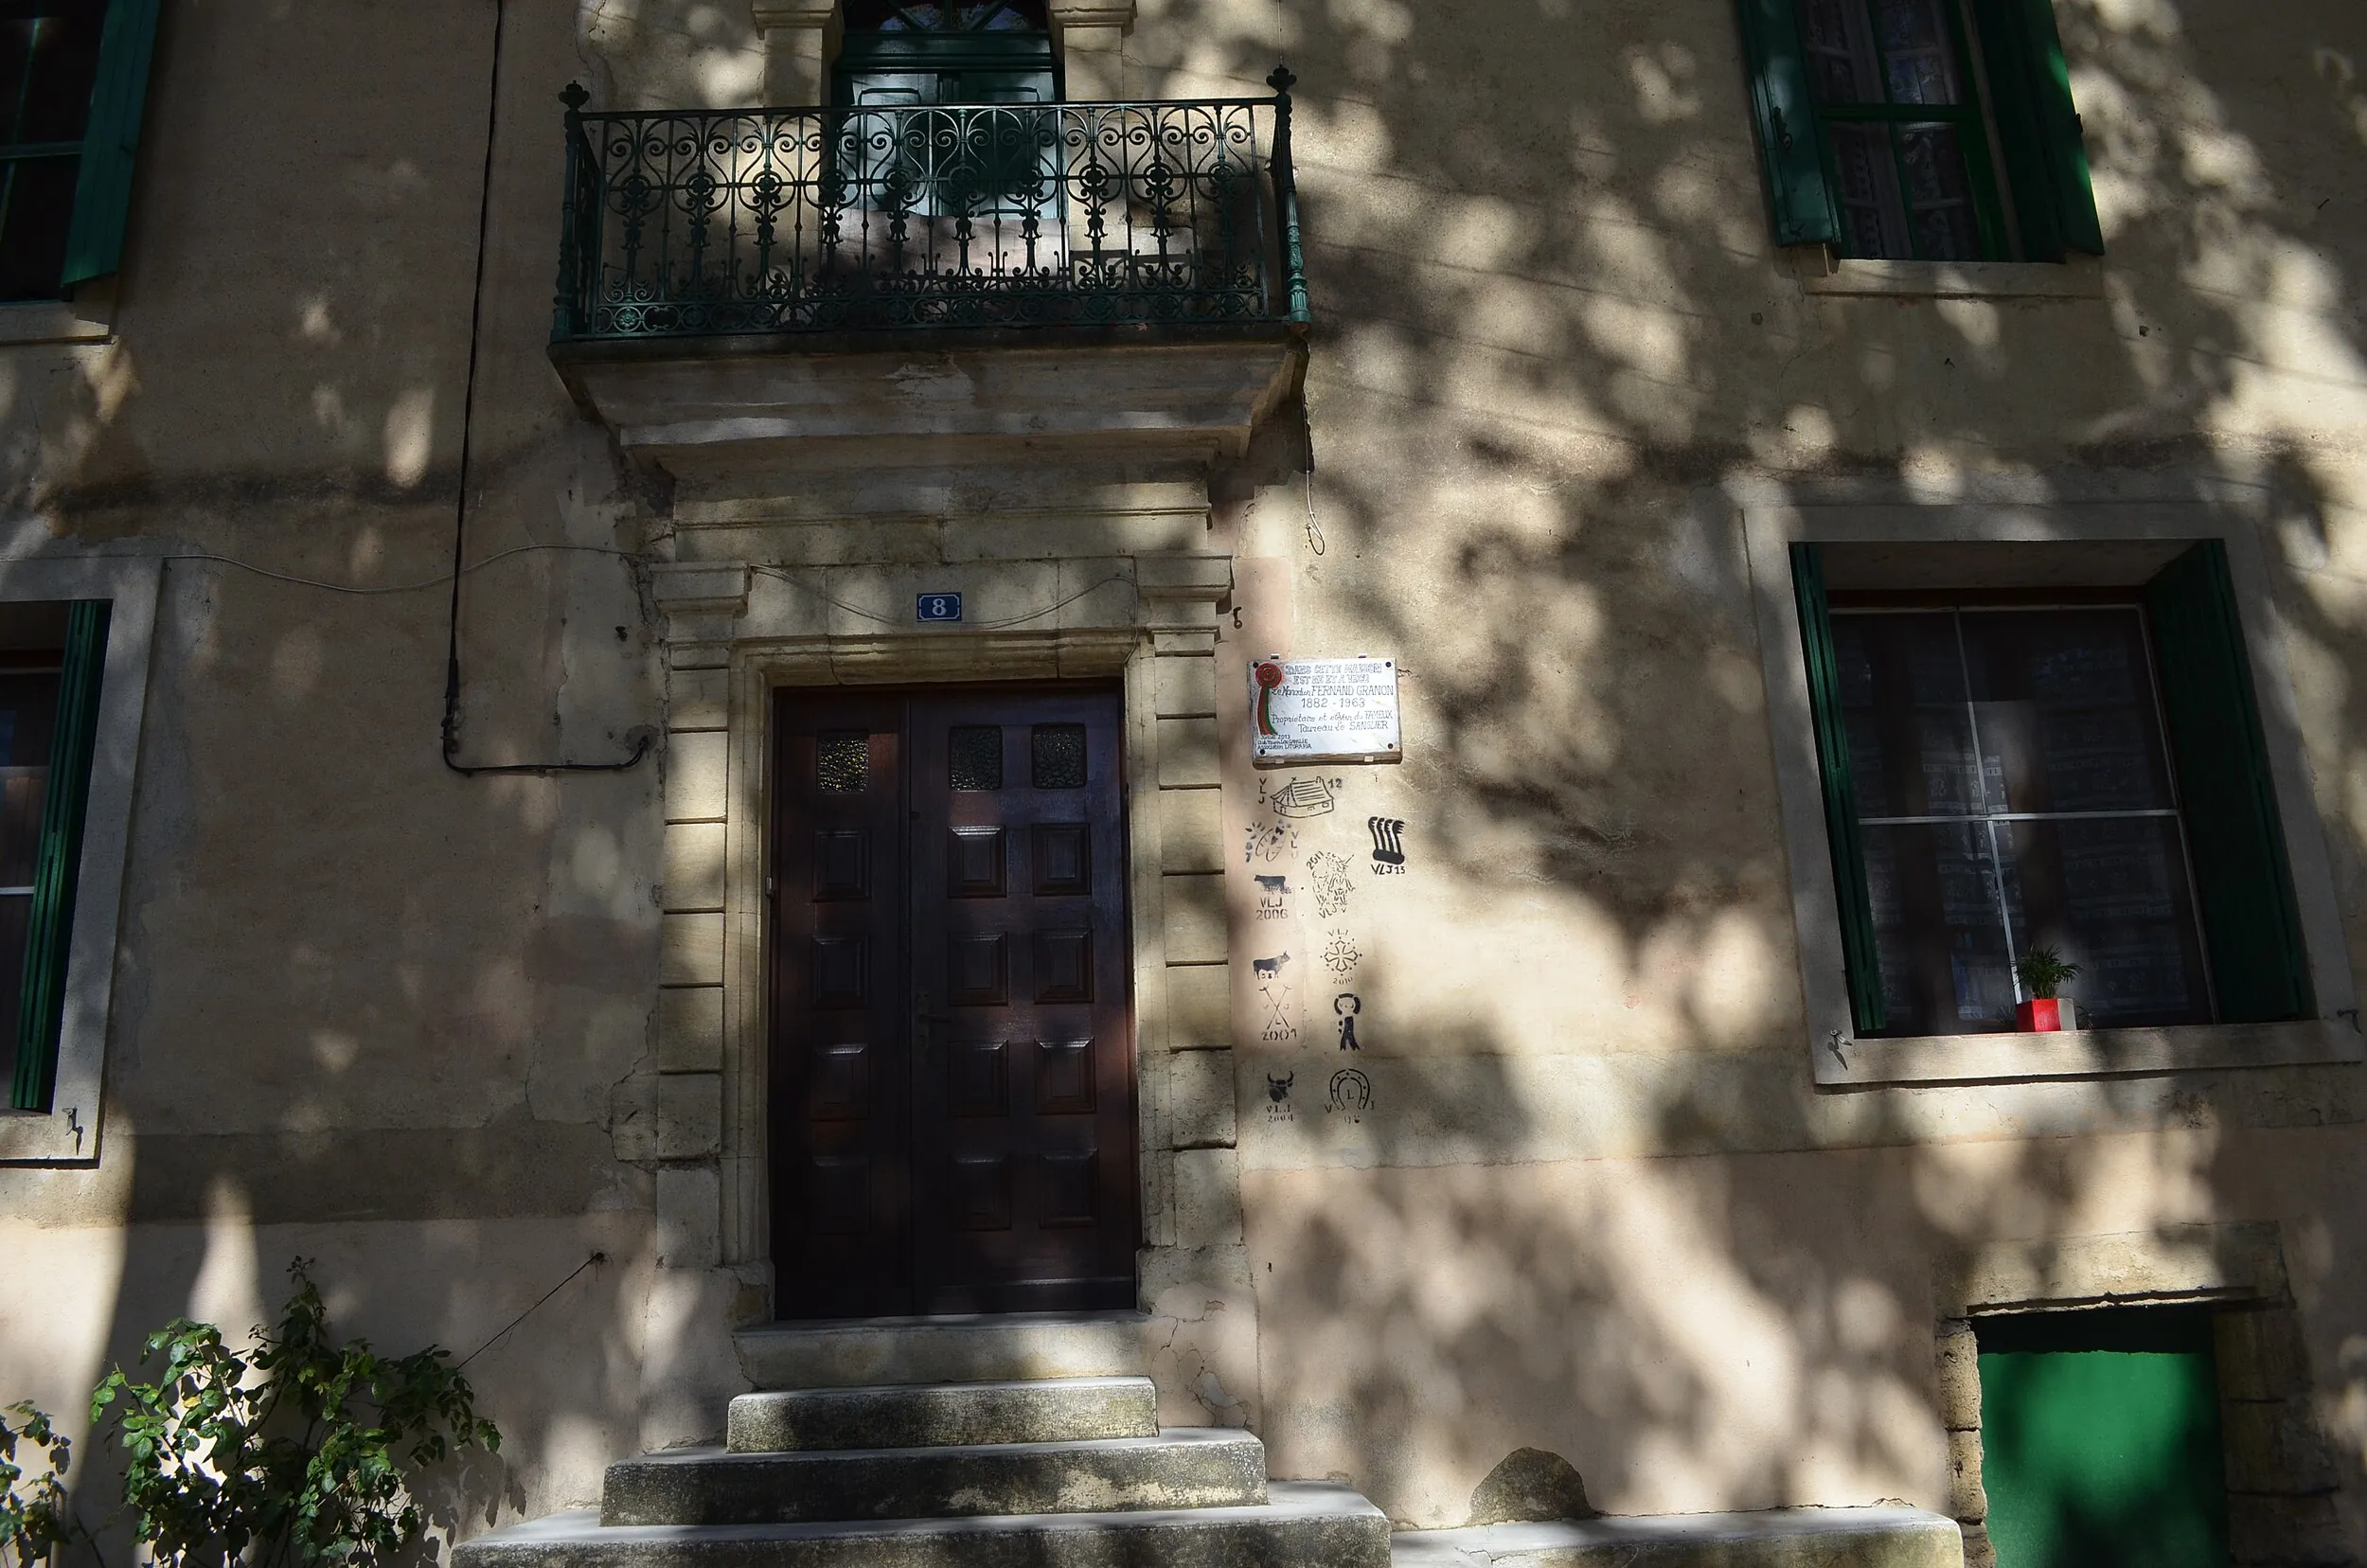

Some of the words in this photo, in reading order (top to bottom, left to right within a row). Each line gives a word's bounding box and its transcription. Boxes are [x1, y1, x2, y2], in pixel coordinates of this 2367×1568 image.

[932, 597, 947, 616] 8
[1285, 665, 1312, 675] DANS
[1314, 664, 1343, 674] CETTE
[1344, 662, 1382, 673] MAISON
[1292, 675, 1311, 686] EST
[1311, 685, 1355, 697] FERNAND
[1356, 685, 1394, 696] GRANON
[1301, 697, 1328, 708] 1882
[1339, 697, 1365, 708] 1963
[1363, 709, 1394, 721] FAMEUX
[1297, 722, 1334, 733] Taureau
[1327, 778, 1344, 789] 12
[1371, 864, 1394, 876] VLJ
[1260, 897, 1284, 909] VLJ
